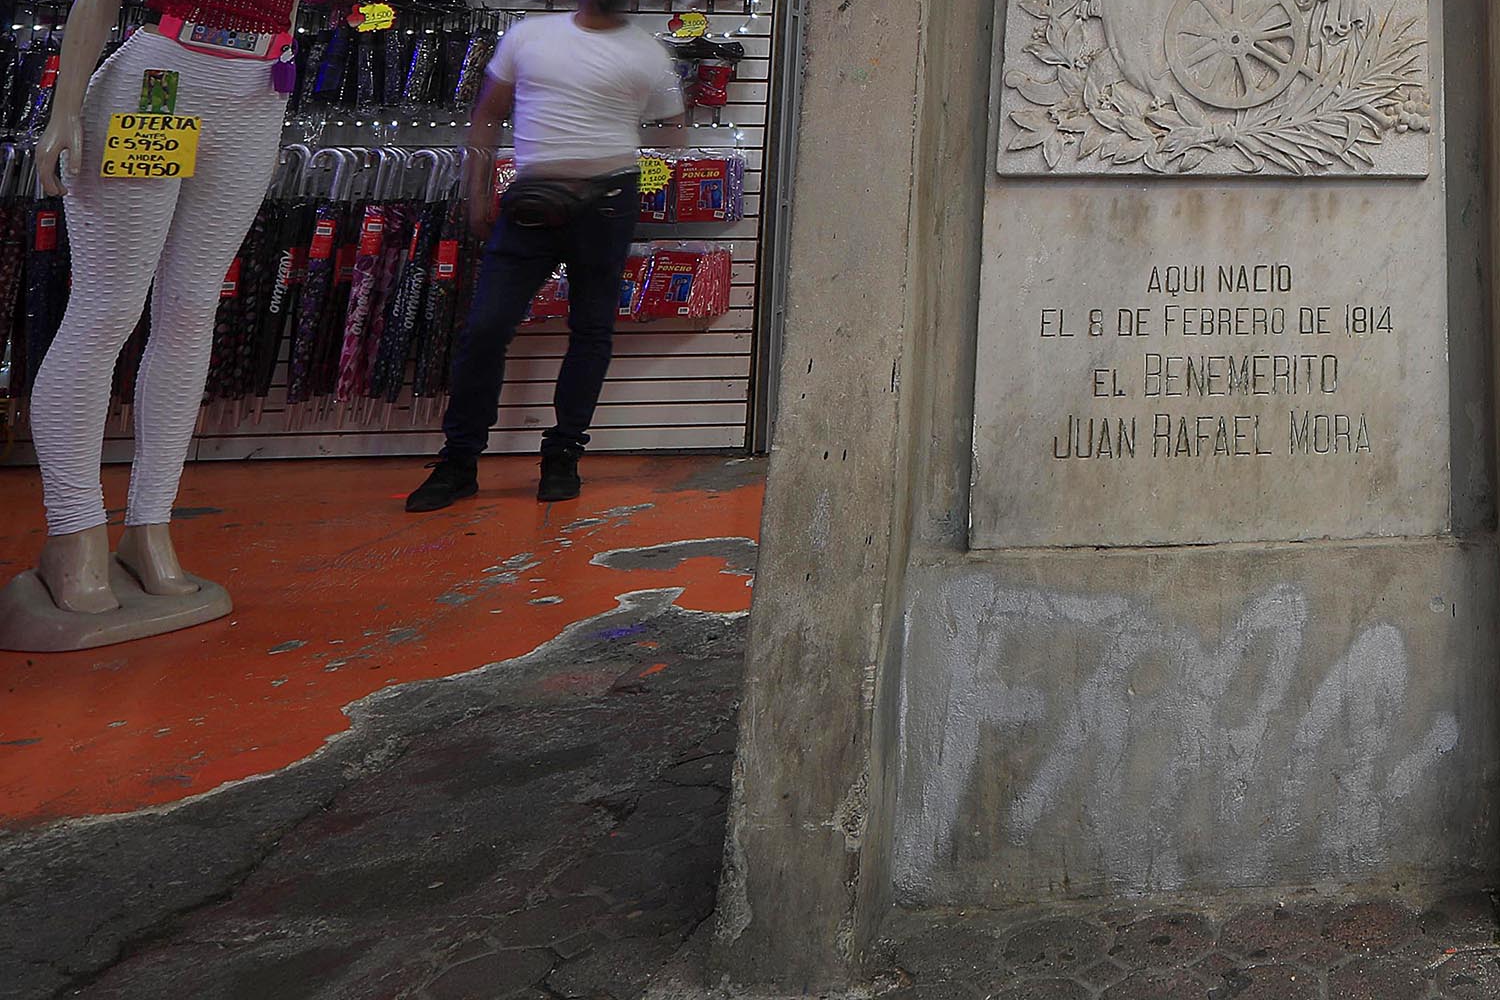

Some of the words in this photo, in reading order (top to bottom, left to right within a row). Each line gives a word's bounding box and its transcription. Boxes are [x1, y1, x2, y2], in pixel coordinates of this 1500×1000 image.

[119, 161, 181, 177] 4.950
[681, 170, 720, 179] PONCHO
[1146, 264, 1205, 297] AQUI
[1218, 264, 1292, 293] NACIO
[1040, 308, 1074, 338] EL
[1088, 308, 1104, 338] 8
[1117, 307, 1151, 337] DE
[1299, 306, 1331, 335] DE
[1344, 304, 1394, 338] 1814
[1092, 368, 1126, 397] EL
[1143, 353, 1338, 398] BENEMERITO
[1053, 414, 1136, 459] JUAN
[1152, 413, 1272, 457] RAFAEL
[1289, 411, 1371, 455] MORA
